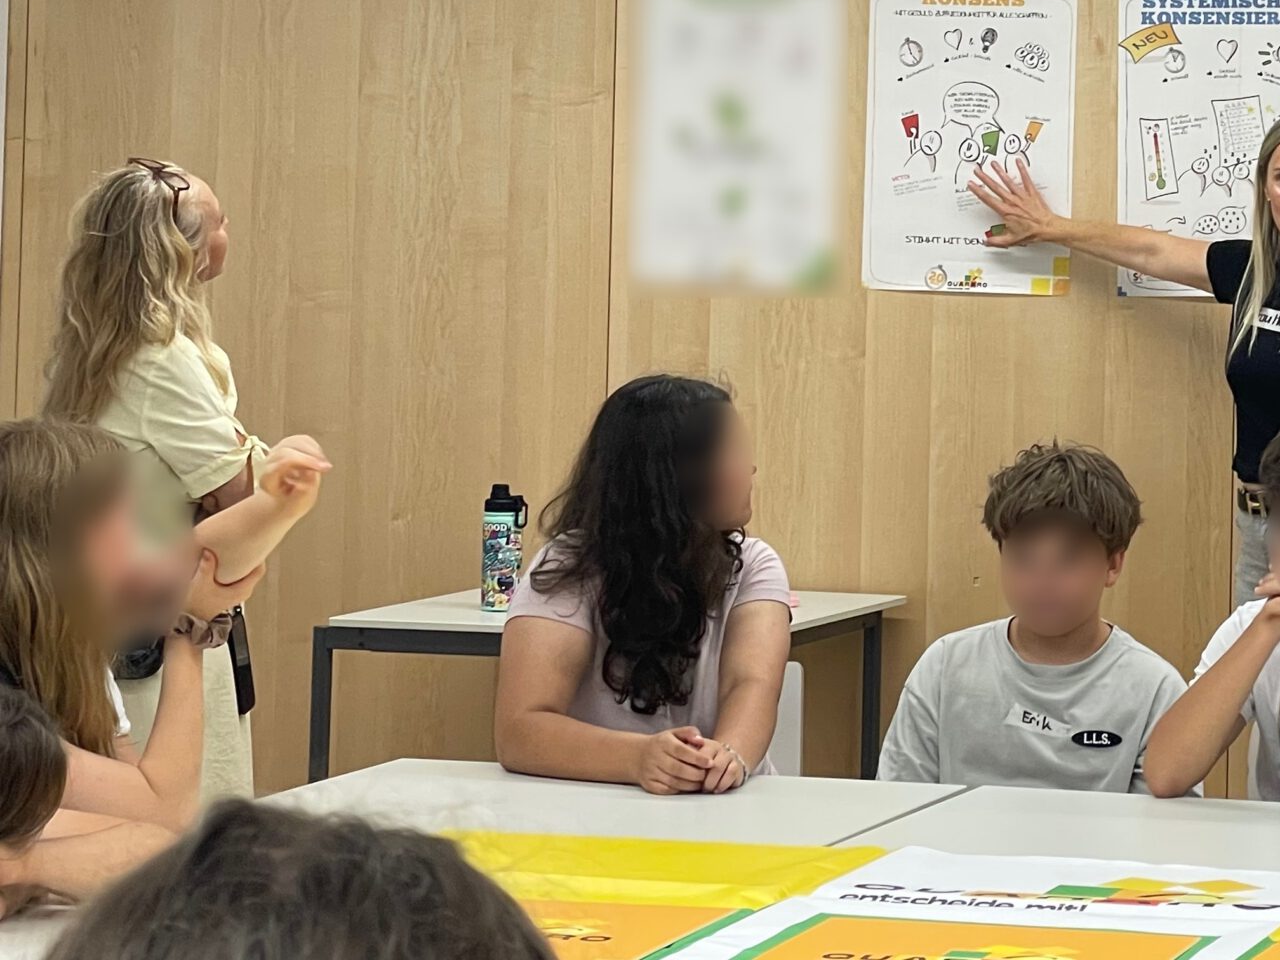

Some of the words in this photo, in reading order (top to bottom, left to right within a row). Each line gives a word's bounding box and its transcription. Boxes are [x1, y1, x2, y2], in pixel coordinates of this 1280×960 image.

[1132, 30, 1169, 51] NEU
[1022, 710, 1053, 732] Erik
[839, 892, 1015, 909] entscheide
